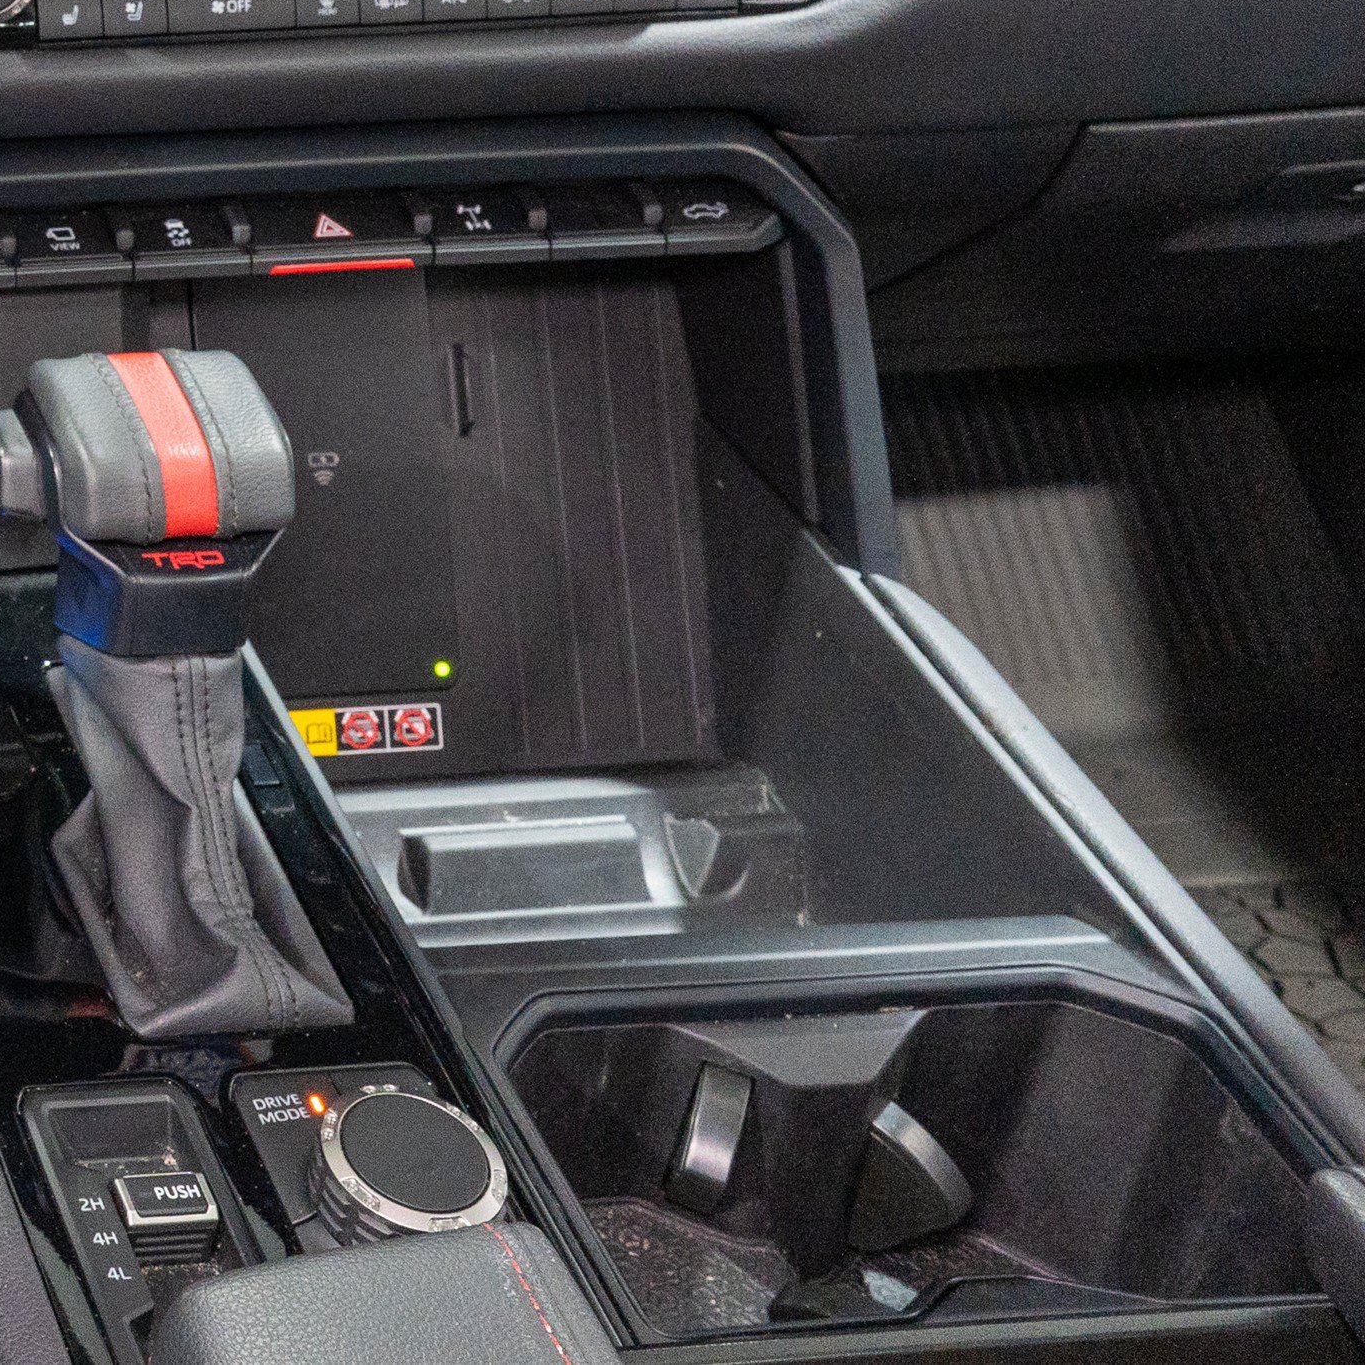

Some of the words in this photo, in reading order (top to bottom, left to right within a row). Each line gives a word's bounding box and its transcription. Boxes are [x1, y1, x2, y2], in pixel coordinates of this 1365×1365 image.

[226, 0, 251, 14] OFF
[51, 242, 80, 251] VIEW
[141, 550, 225, 570] TRD
[252, 1093, 302, 1112] DRIVE
[257, 1106, 310, 1126] MODE
[154, 1183, 201, 1201] PUSH
[80, 1197, 104, 1212] 2H
[92, 1232, 118, 1247] 4H
[106, 1267, 132, 1282] 4L
